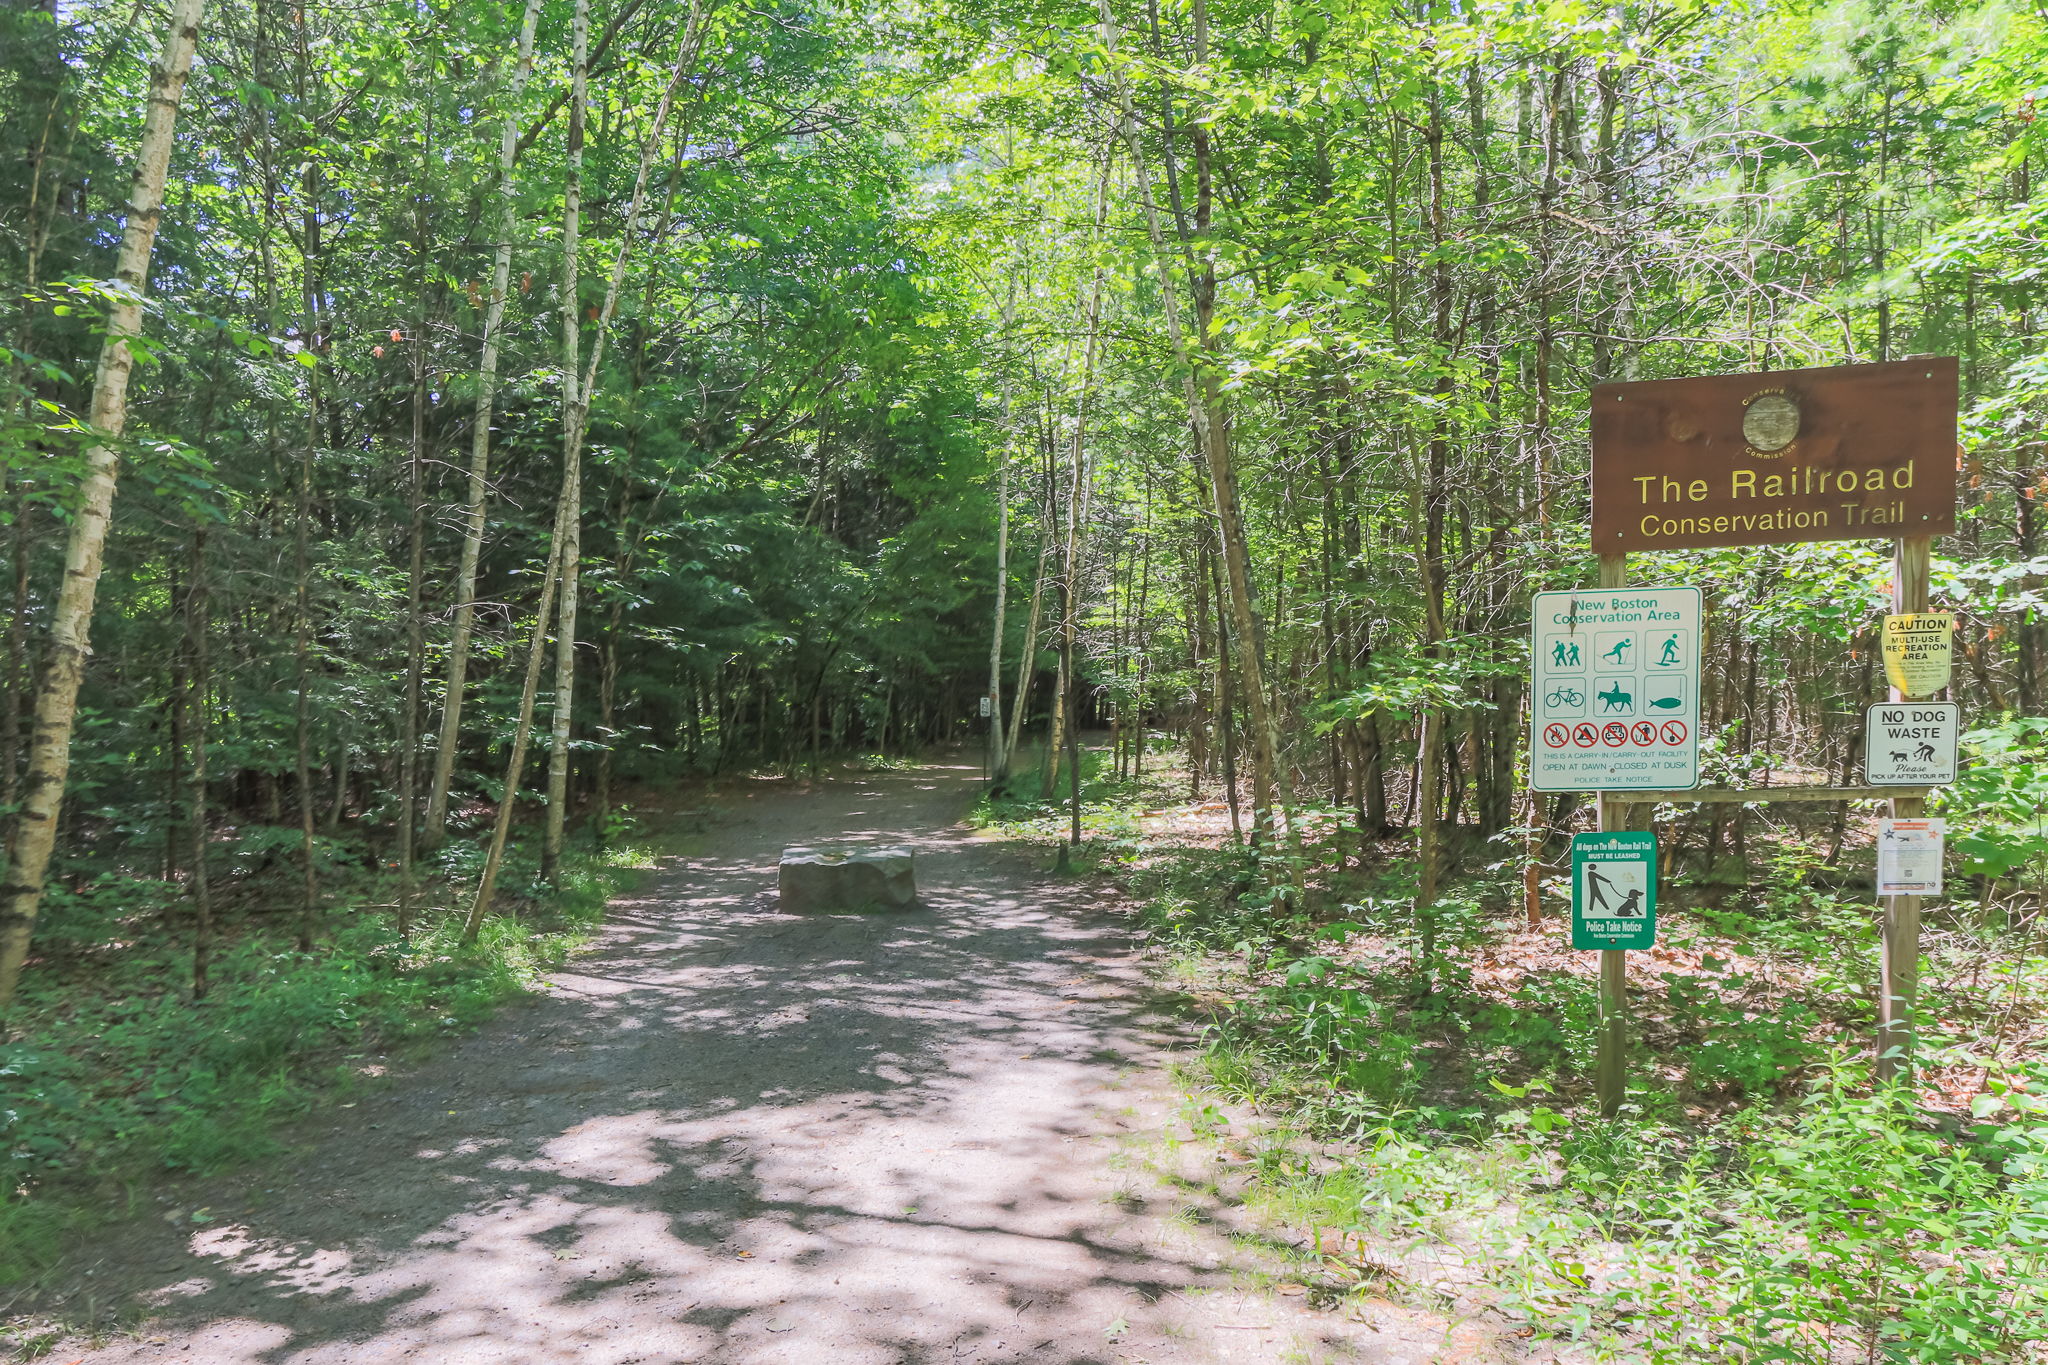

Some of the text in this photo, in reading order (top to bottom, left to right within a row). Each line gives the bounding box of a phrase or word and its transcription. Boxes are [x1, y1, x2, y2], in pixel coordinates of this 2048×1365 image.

[1745, 444, 1797, 459] Commission
[1633, 459, 1914, 504] The Railroad
[1640, 501, 1904, 537] Conservation Trail
[1575, 598, 1658, 611] New Boston
[1553, 610, 1680, 625] Conservation Area
[1889, 619, 1947, 631] CAUTION
[1891, 635, 1941, 644] MULTI-USE
[1885, 644, 1947, 652] RECREATION
[1902, 652, 1928, 660] AREA
[1881, 711, 1946, 722] NO DOG
[1888, 727, 1941, 739] WASTE
[1544, 752, 1558, 760] THIS
[1658, 750, 1688, 758] FACILITY
[1542, 763, 1566, 771] OPEN
[1613, 762, 1648, 770] CLOSED
[1664, 761, 1688, 769] DUSK
[1895, 763, 1927, 773] Please
[1586, 921, 1642, 932] Police Take Notice
